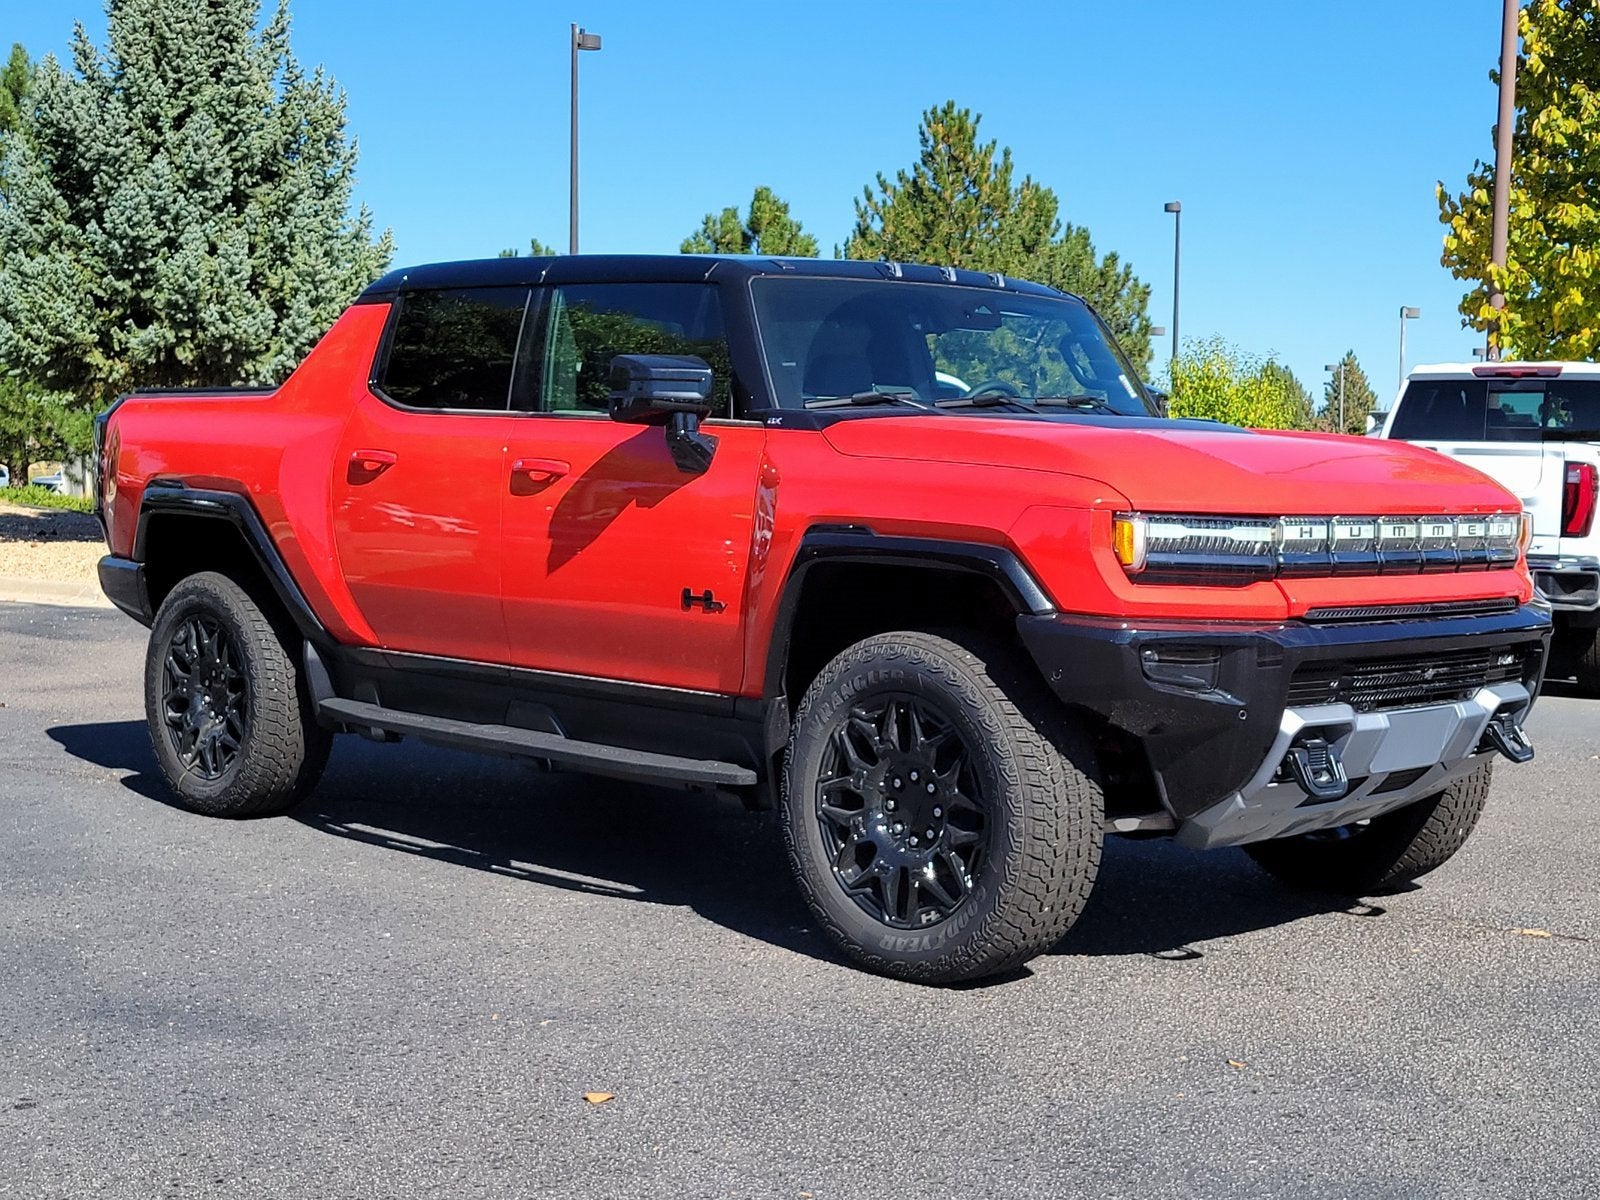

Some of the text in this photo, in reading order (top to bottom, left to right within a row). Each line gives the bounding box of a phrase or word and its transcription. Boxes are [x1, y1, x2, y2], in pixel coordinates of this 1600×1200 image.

[1299, 521, 1506, 538] HUMMER
[806, 669, 905, 739] WRANGLER
[879, 885, 987, 952] GOODYEAR
